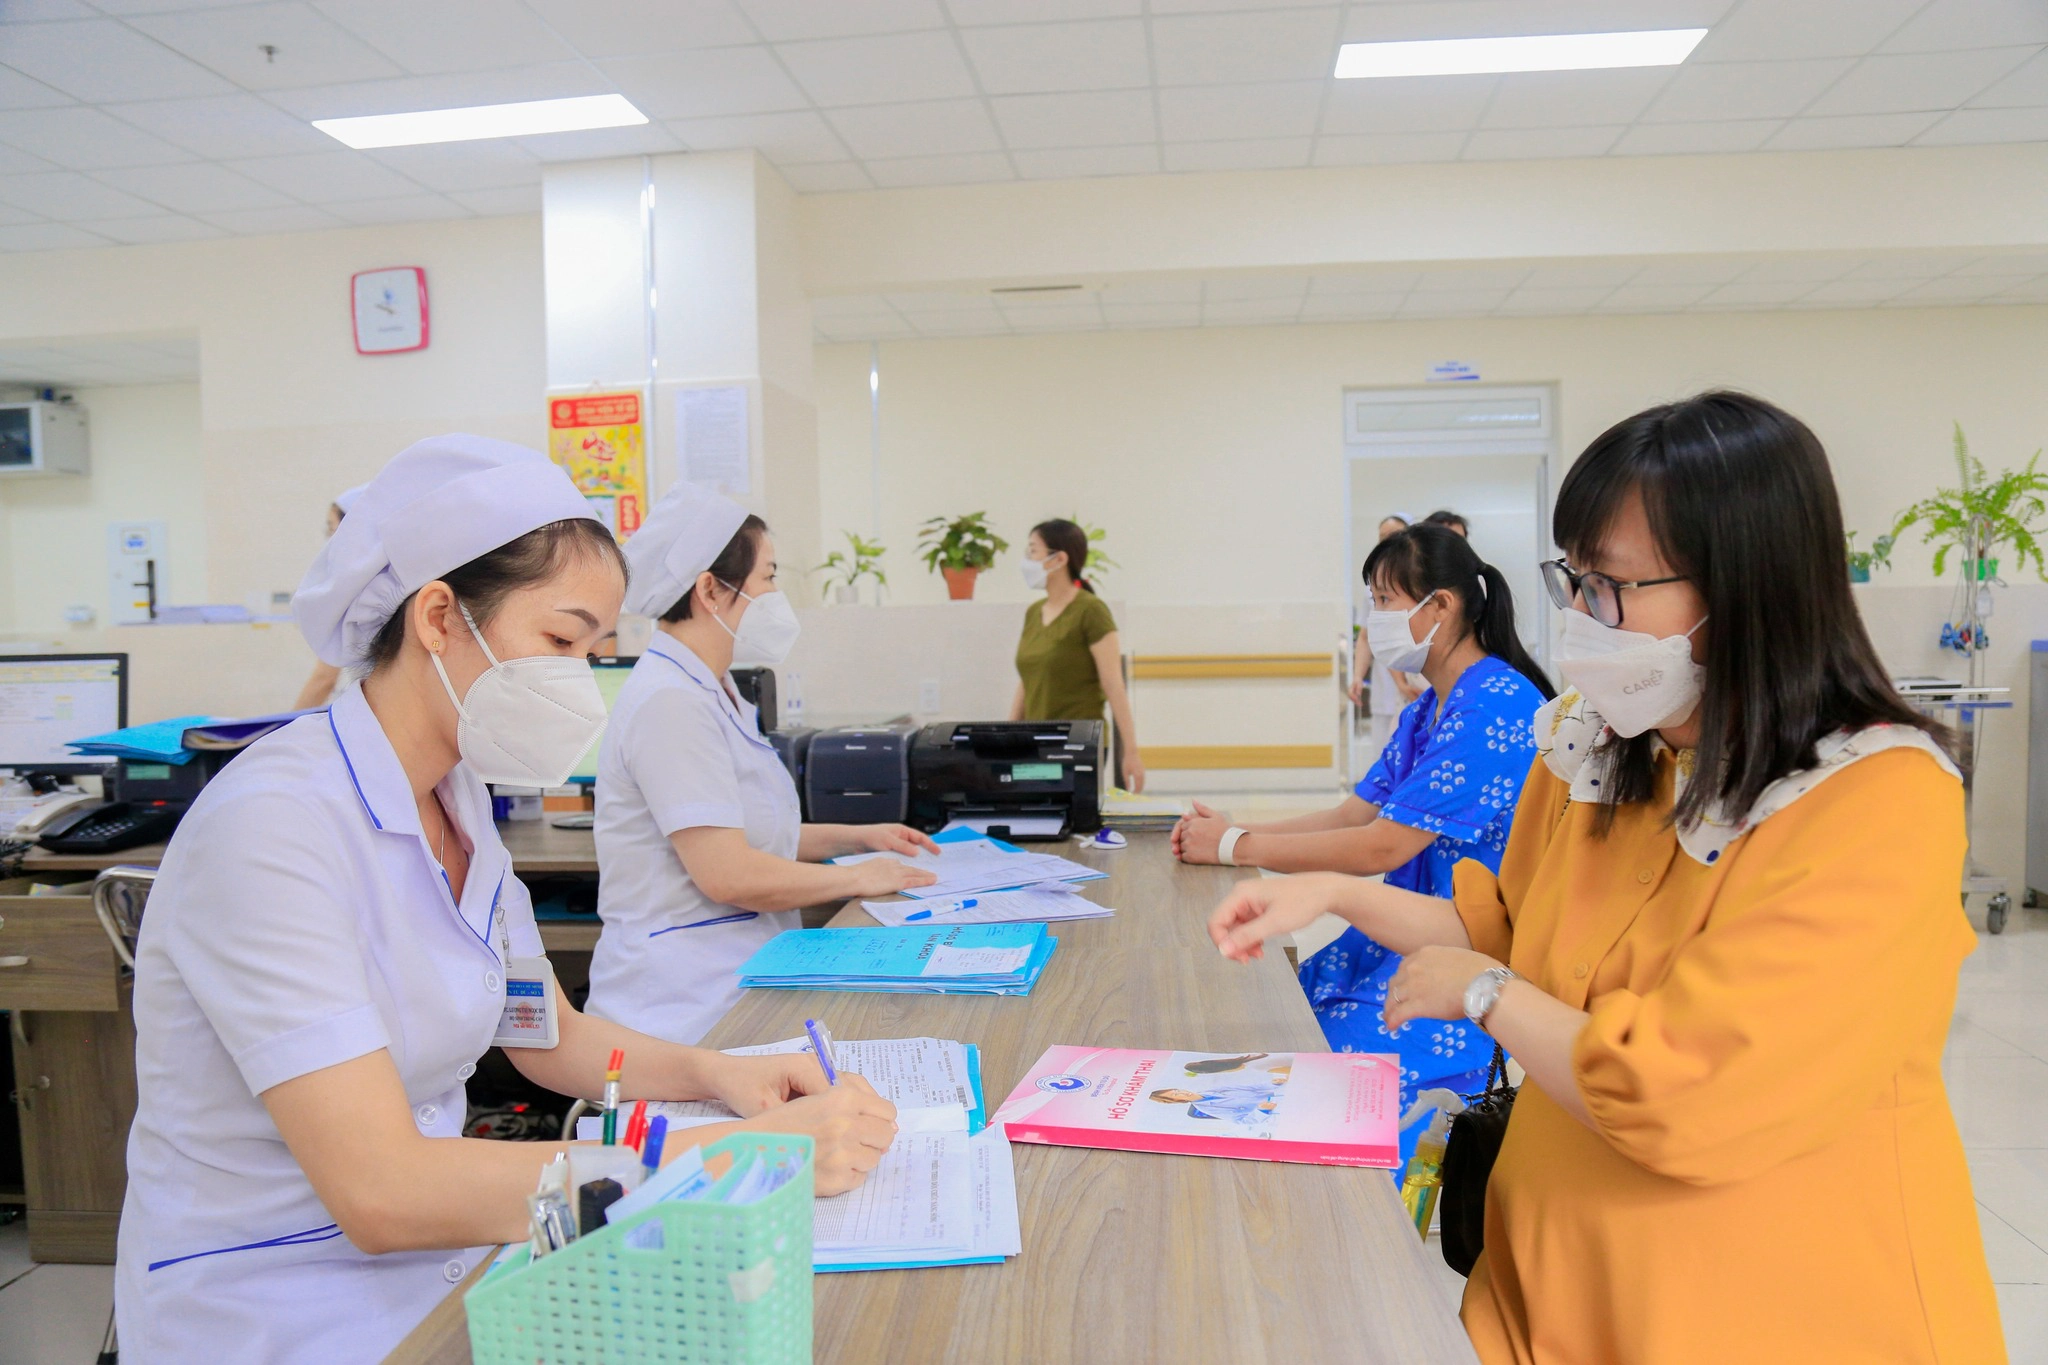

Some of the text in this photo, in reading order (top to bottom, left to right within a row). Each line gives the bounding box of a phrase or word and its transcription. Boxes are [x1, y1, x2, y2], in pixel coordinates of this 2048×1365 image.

[1134, 1060, 1157, 1075] THAI
[1121, 1075, 1148, 1096] KHÁM
[1115, 1096, 1135, 1107] SƠ
